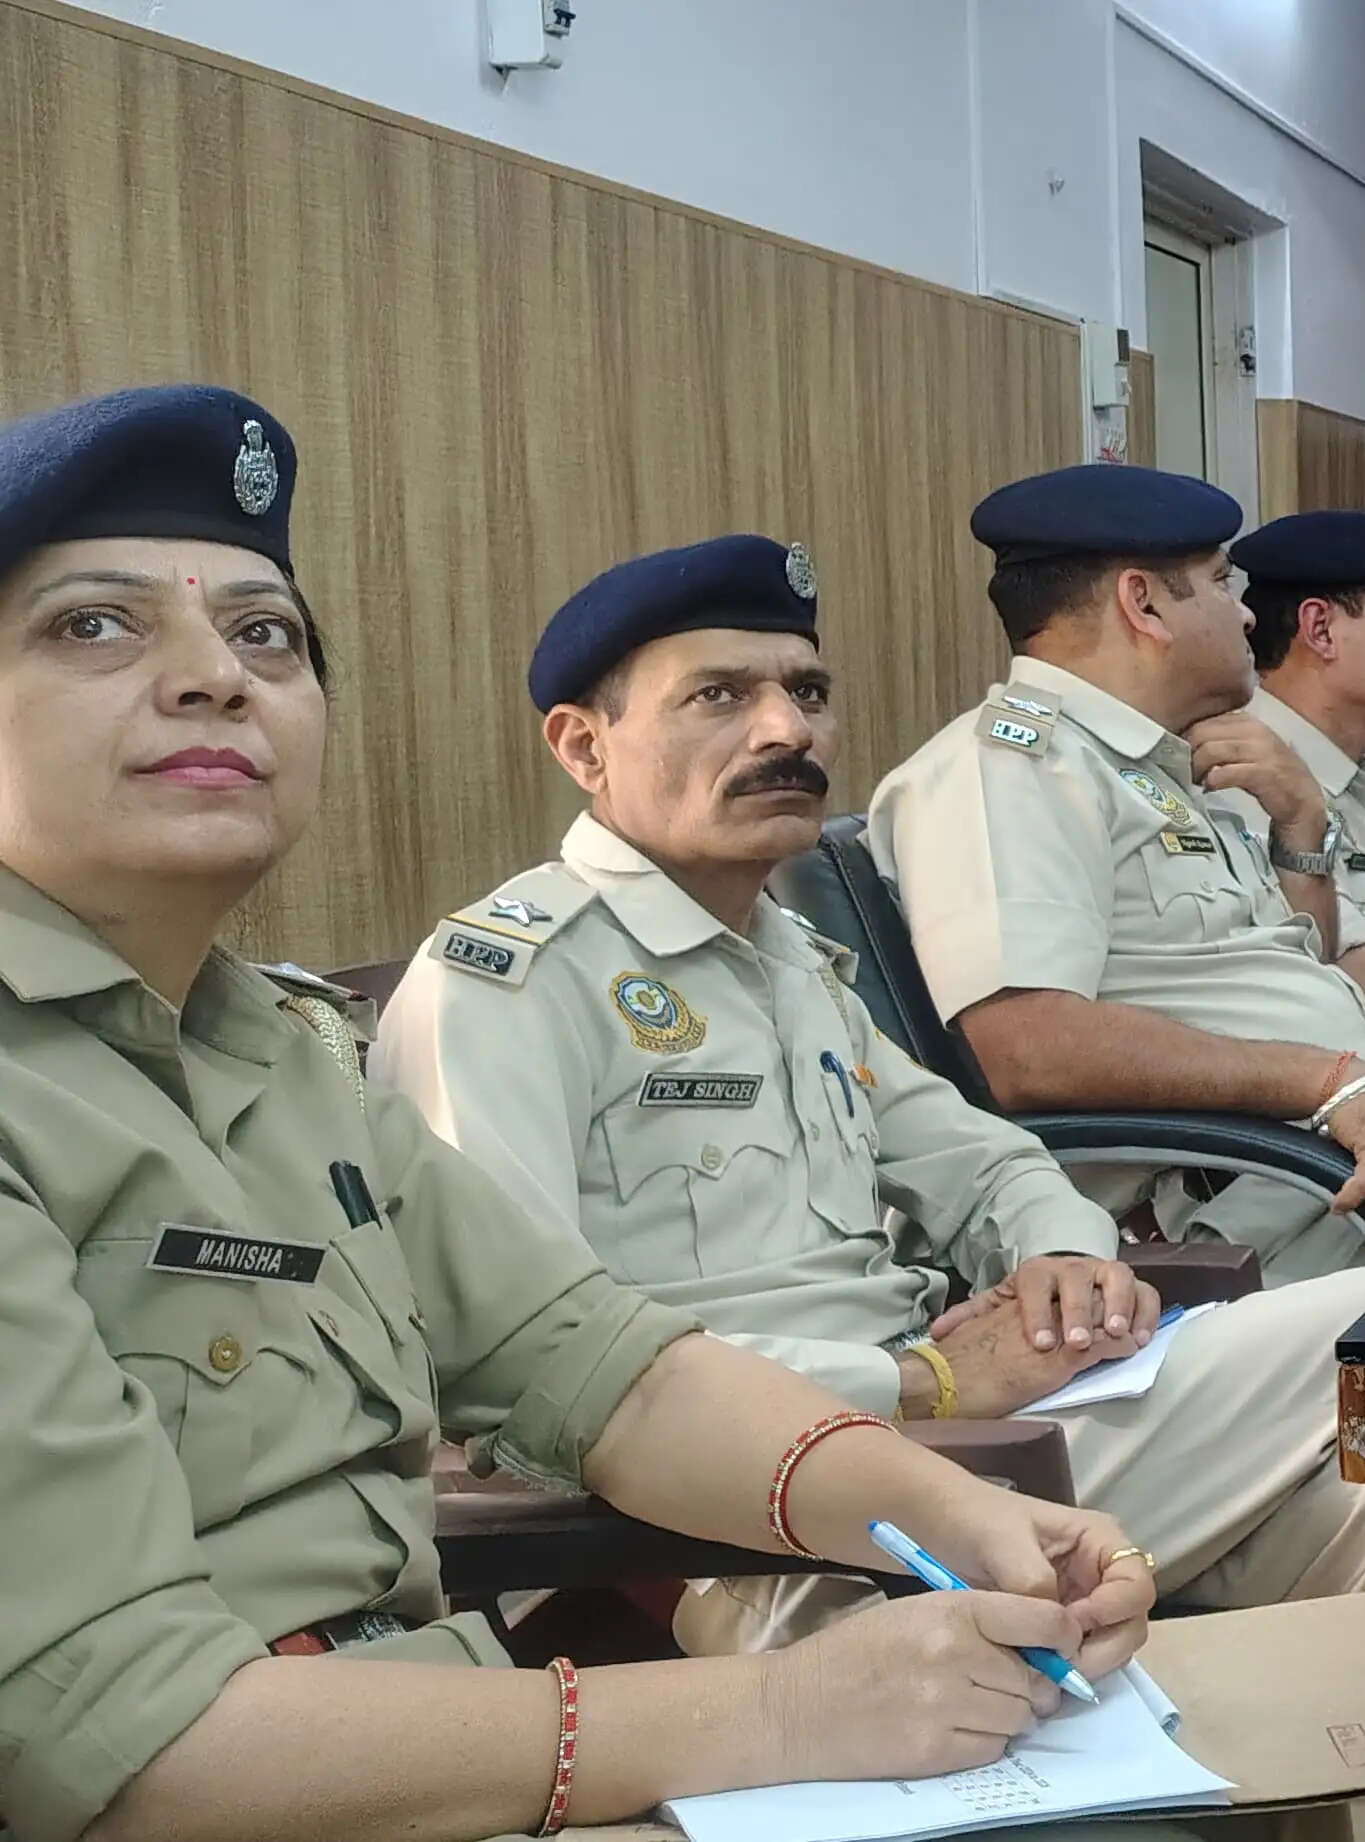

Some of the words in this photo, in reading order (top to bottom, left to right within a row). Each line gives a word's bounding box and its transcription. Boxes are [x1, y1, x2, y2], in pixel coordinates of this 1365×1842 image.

[991, 719, 1039, 747] HPP
[652, 1080, 691, 1099] TEJ
[693, 1080, 755, 1100] SINGH
[195, 1239, 284, 1274] MANISHA
